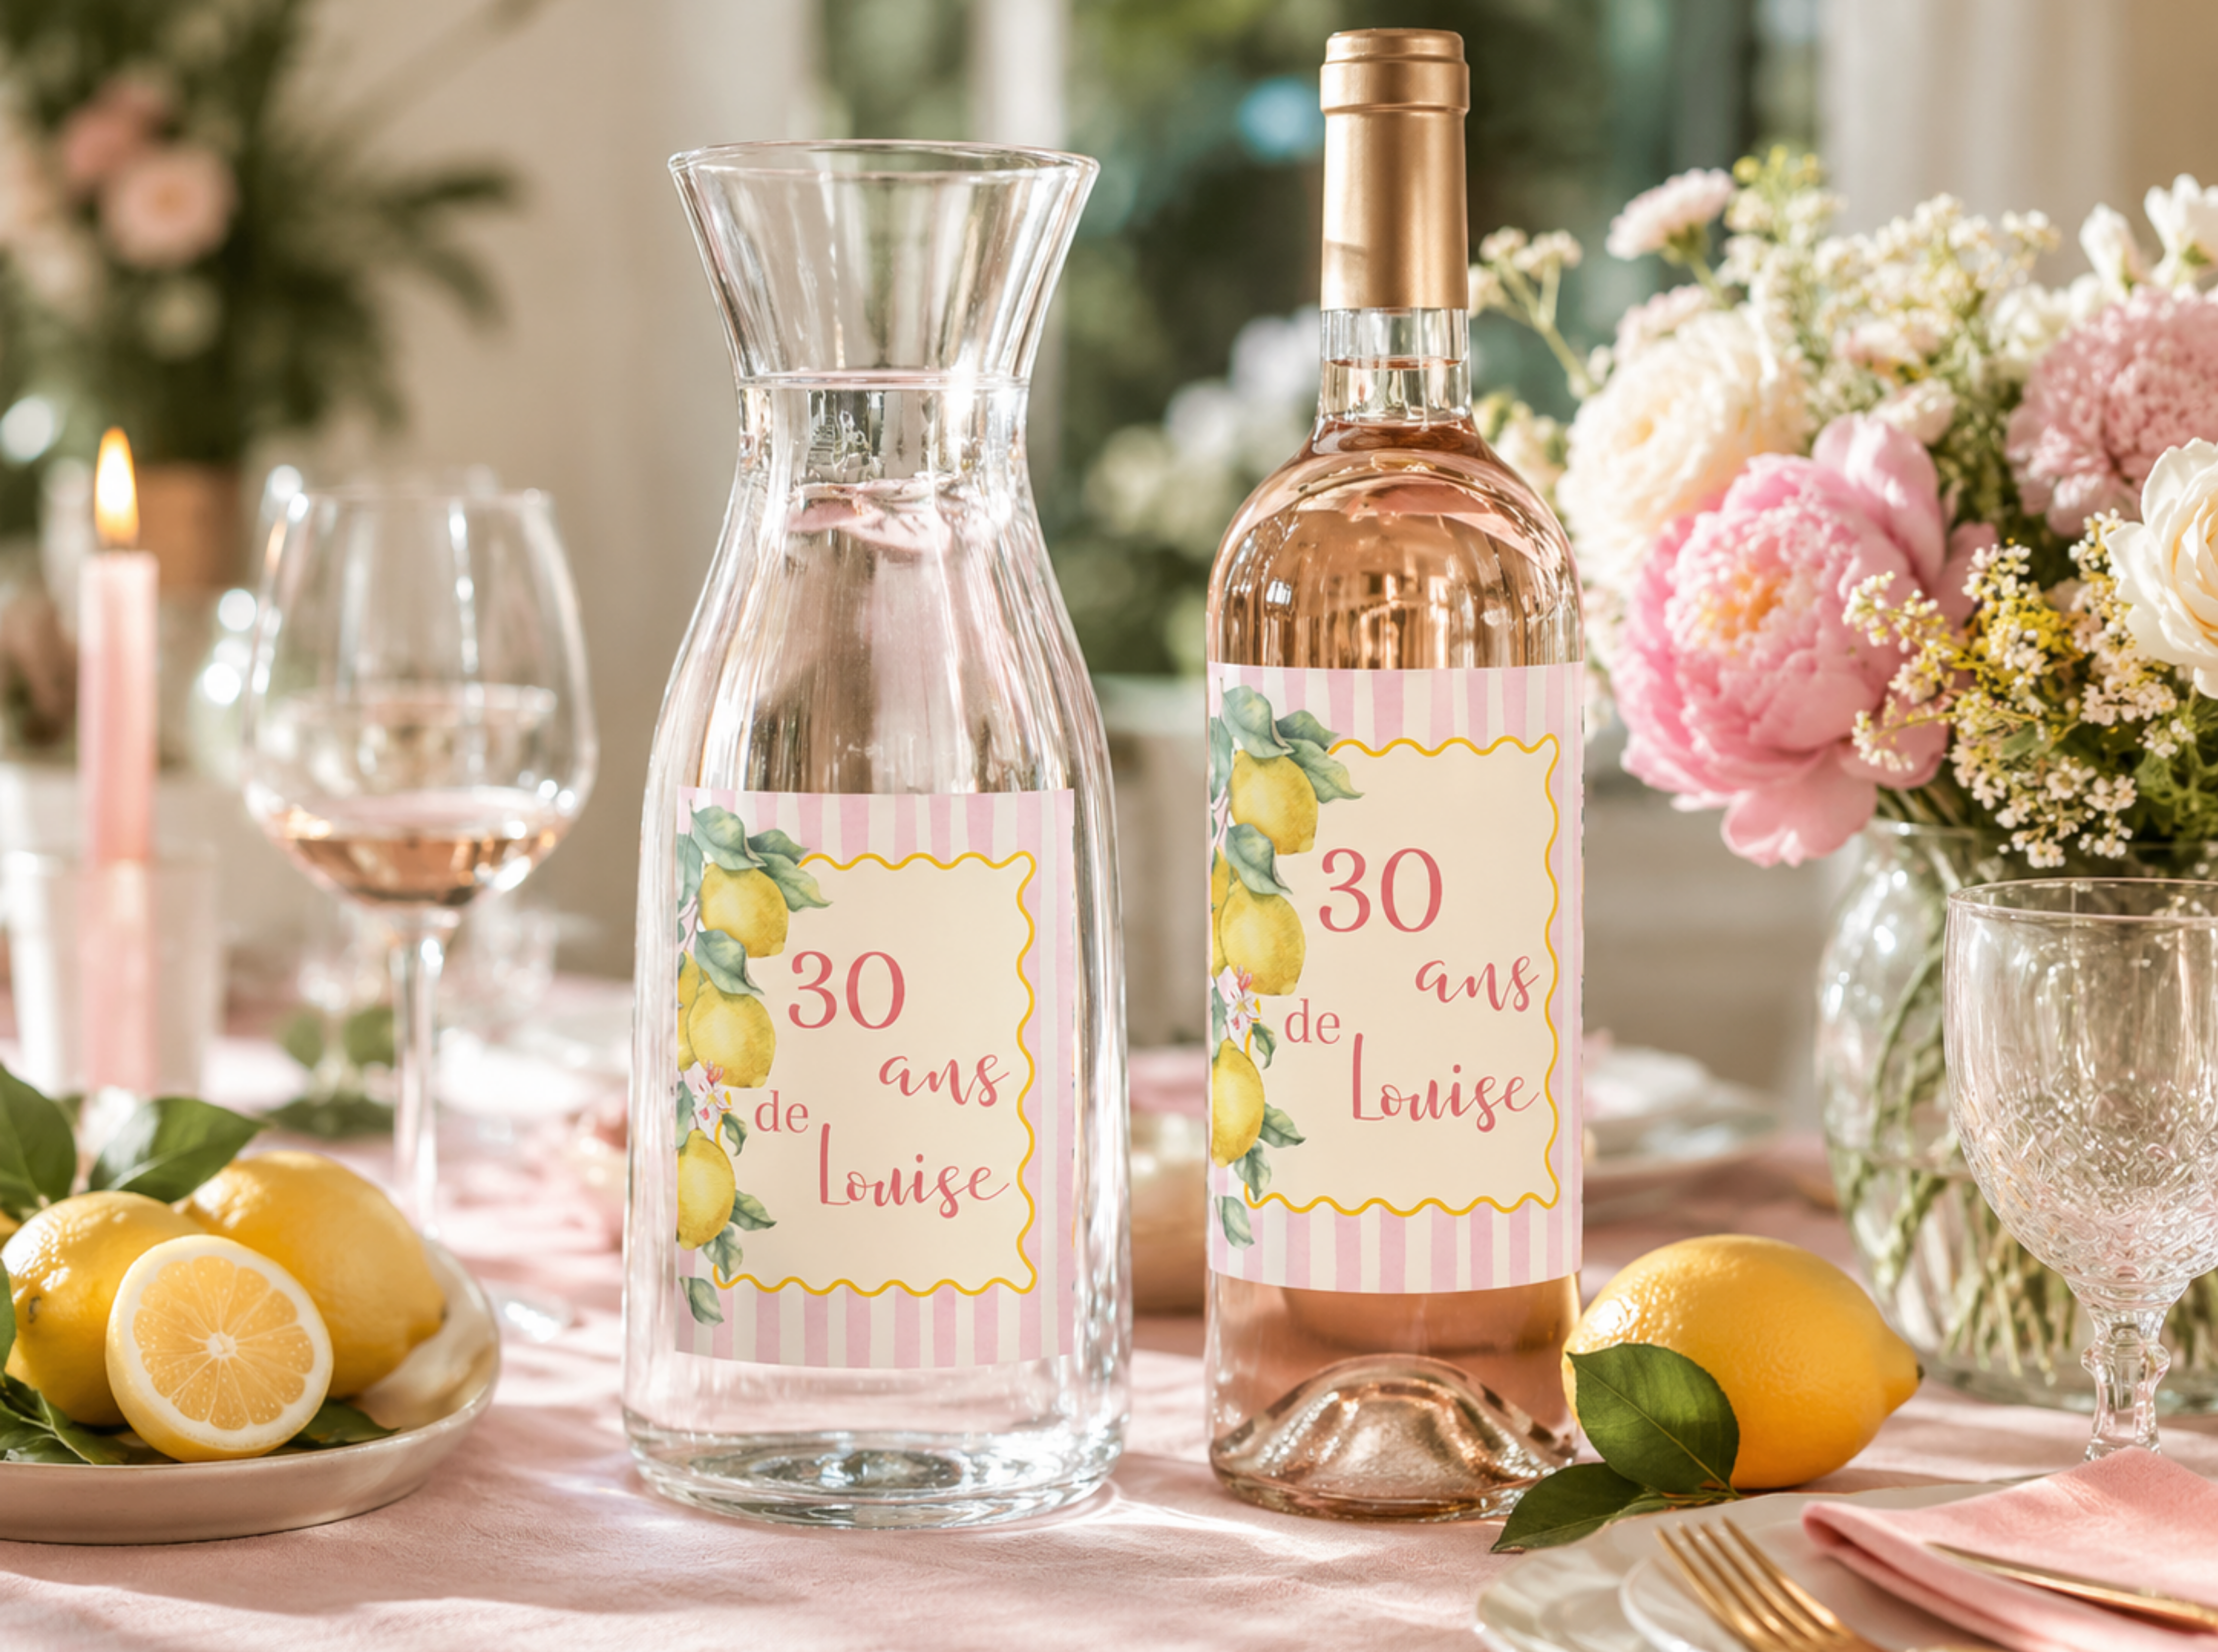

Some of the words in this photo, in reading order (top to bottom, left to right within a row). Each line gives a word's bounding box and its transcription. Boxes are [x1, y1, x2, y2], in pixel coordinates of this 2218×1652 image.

[1319, 848, 1442, 932] 30
[789, 951, 905, 1029] 30
[1415, 956, 1539, 1011] ans
[1285, 998, 1340, 1044] de
[755, 1090, 809, 1132] de
[879, 1055, 1009, 1107] ans
[1353, 1033, 1539, 1132] Louise
[820, 1123, 1009, 1218] Louise
